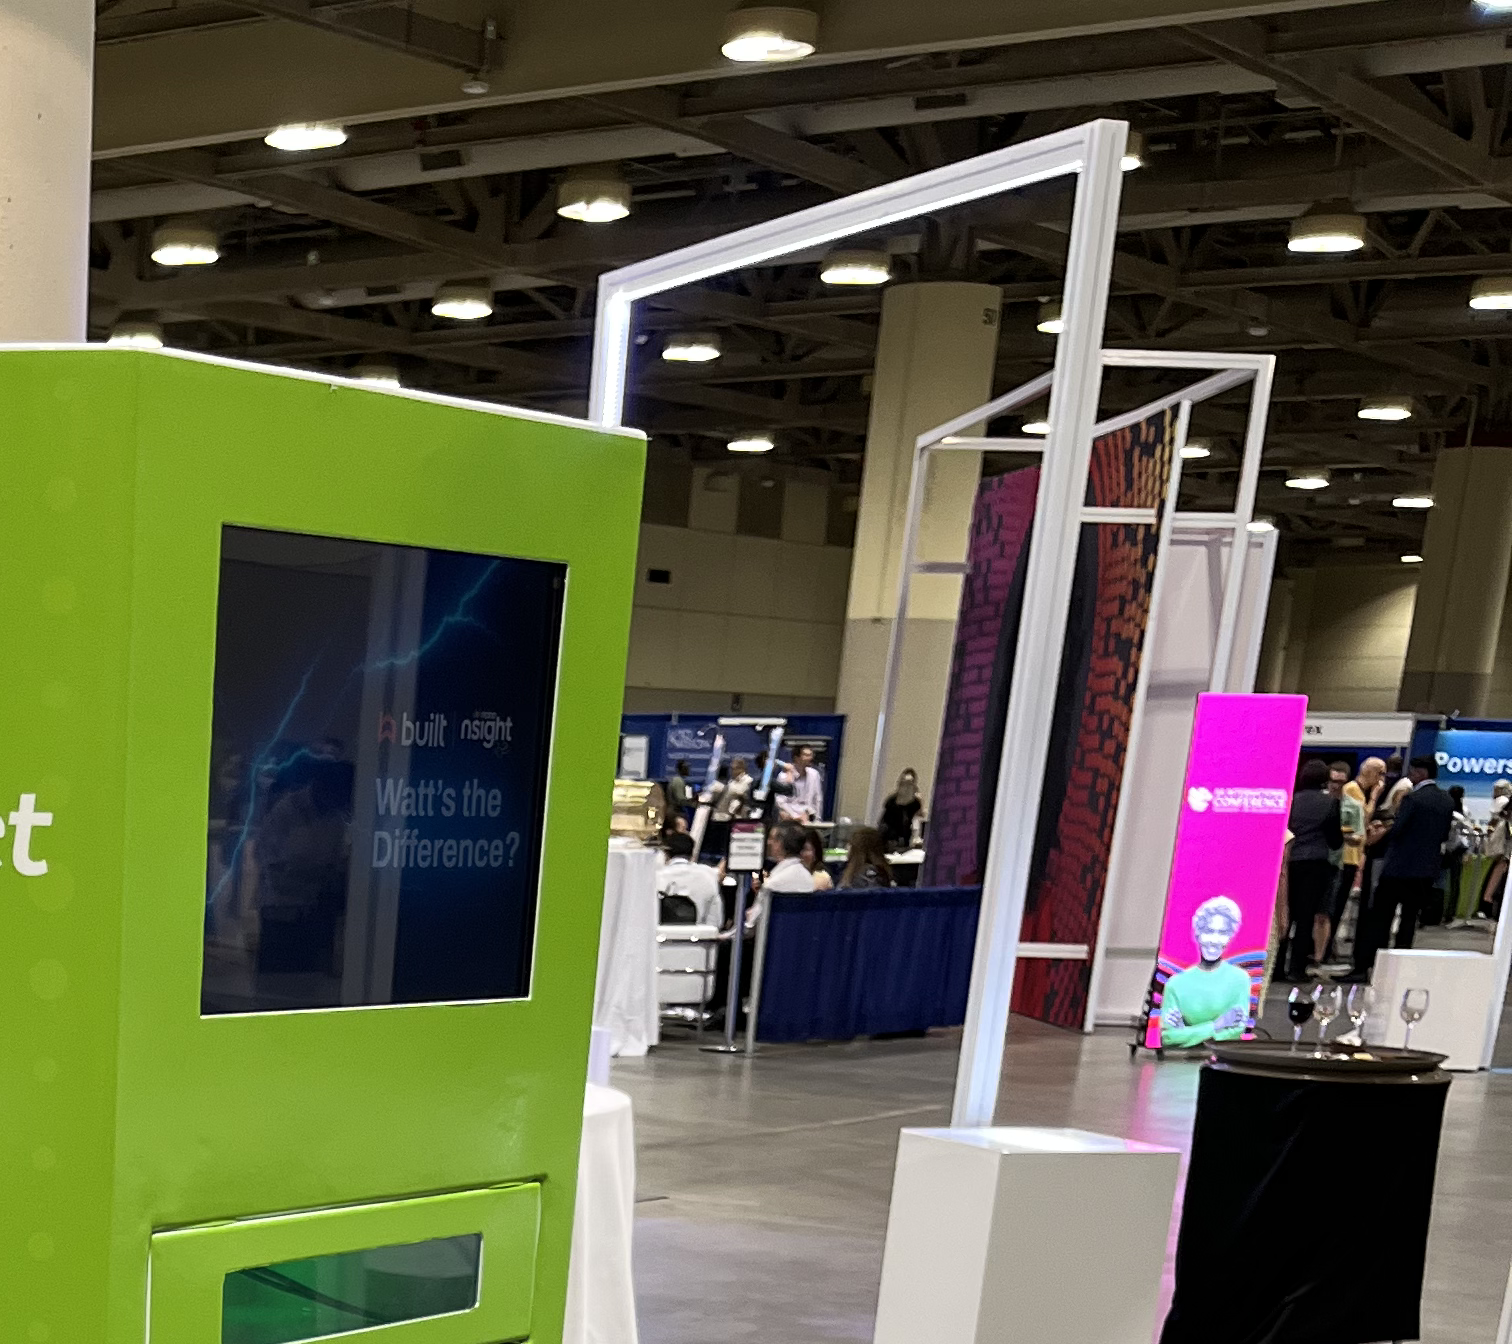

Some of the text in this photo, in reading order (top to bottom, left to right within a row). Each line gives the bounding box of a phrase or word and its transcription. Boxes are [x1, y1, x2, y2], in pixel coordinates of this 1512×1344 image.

[401, 712, 448, 747] built
[376, 778, 502, 817] Watt's the
[372, 828, 520, 868] Difference?
